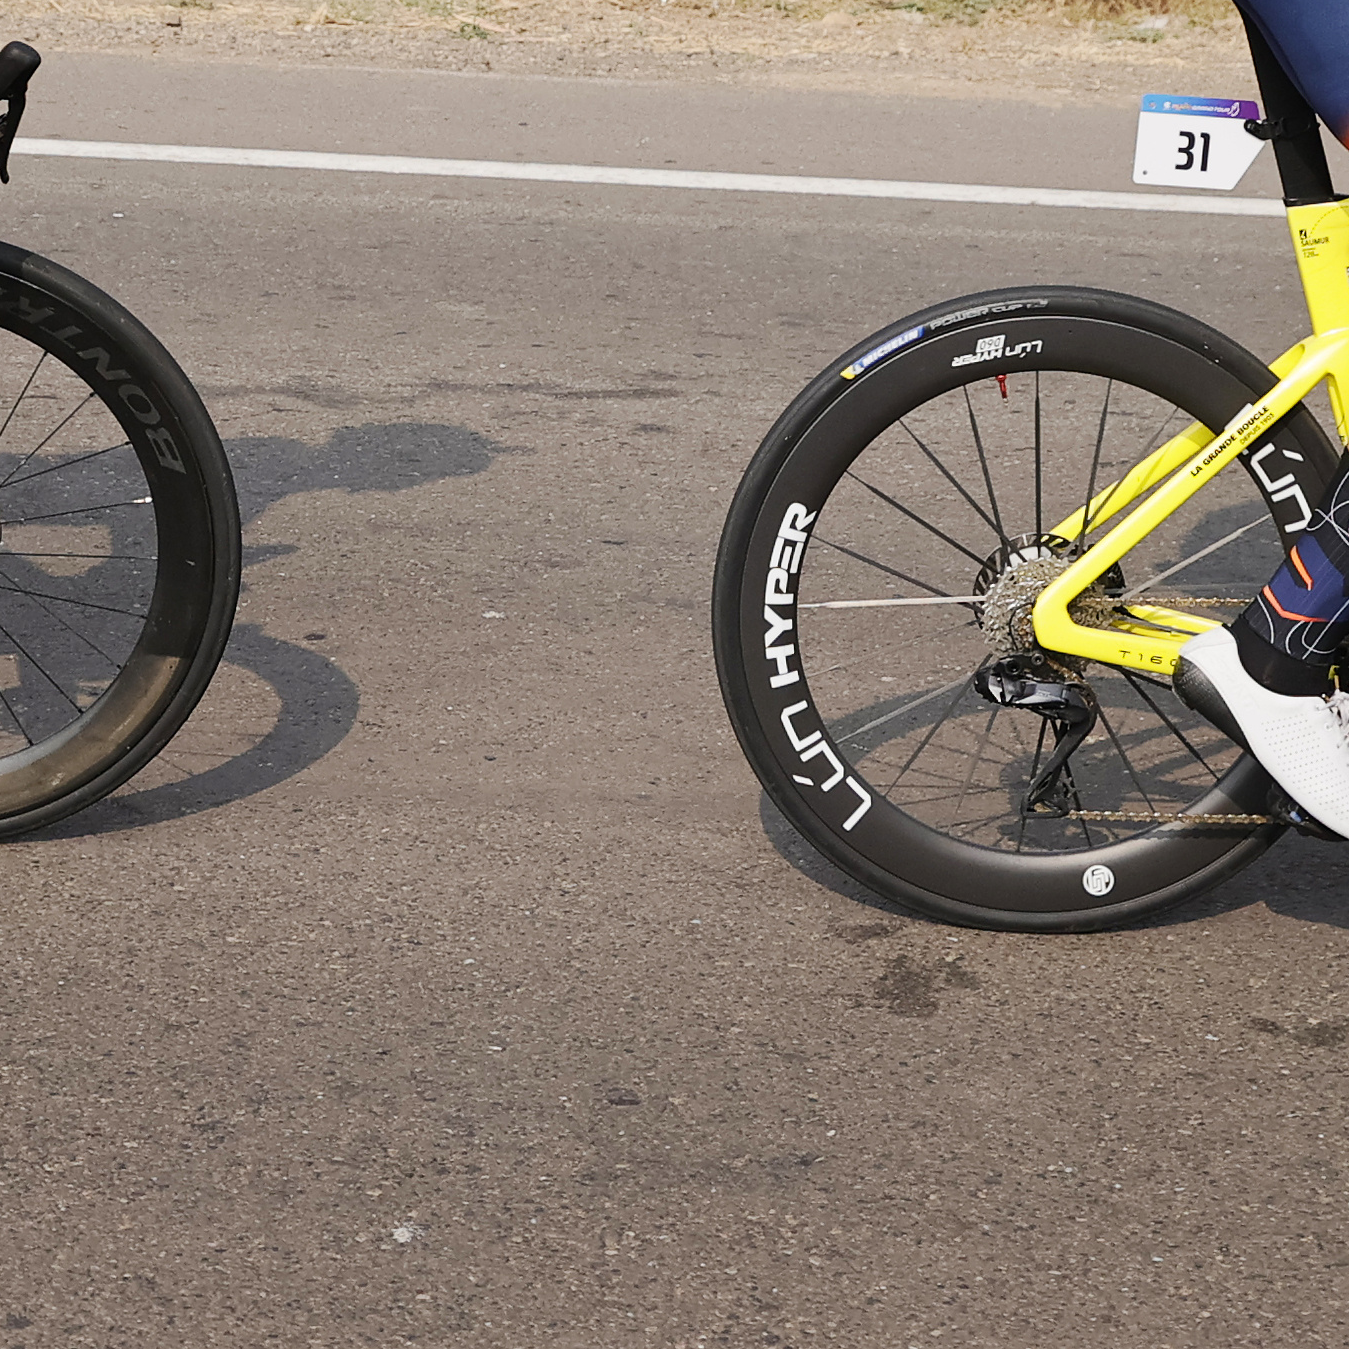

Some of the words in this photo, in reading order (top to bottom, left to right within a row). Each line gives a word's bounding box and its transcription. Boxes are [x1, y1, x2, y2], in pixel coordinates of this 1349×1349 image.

[1175, 131, 1210, 172] 31
[862, 329, 918, 366] MICHELIN
[930, 306, 989, 330] POWER
[992, 303, 1023, 313] CUP
[952, 350, 1002, 367] HYPER
[1190, 465, 1202, 477] LA
[1202, 435, 1237, 466] GRANDE
[1237, 405, 1269, 436] BOUCLE
[1239, 423, 1261, 445] DEPUIS
[764, 502, 816, 688] HYPER
